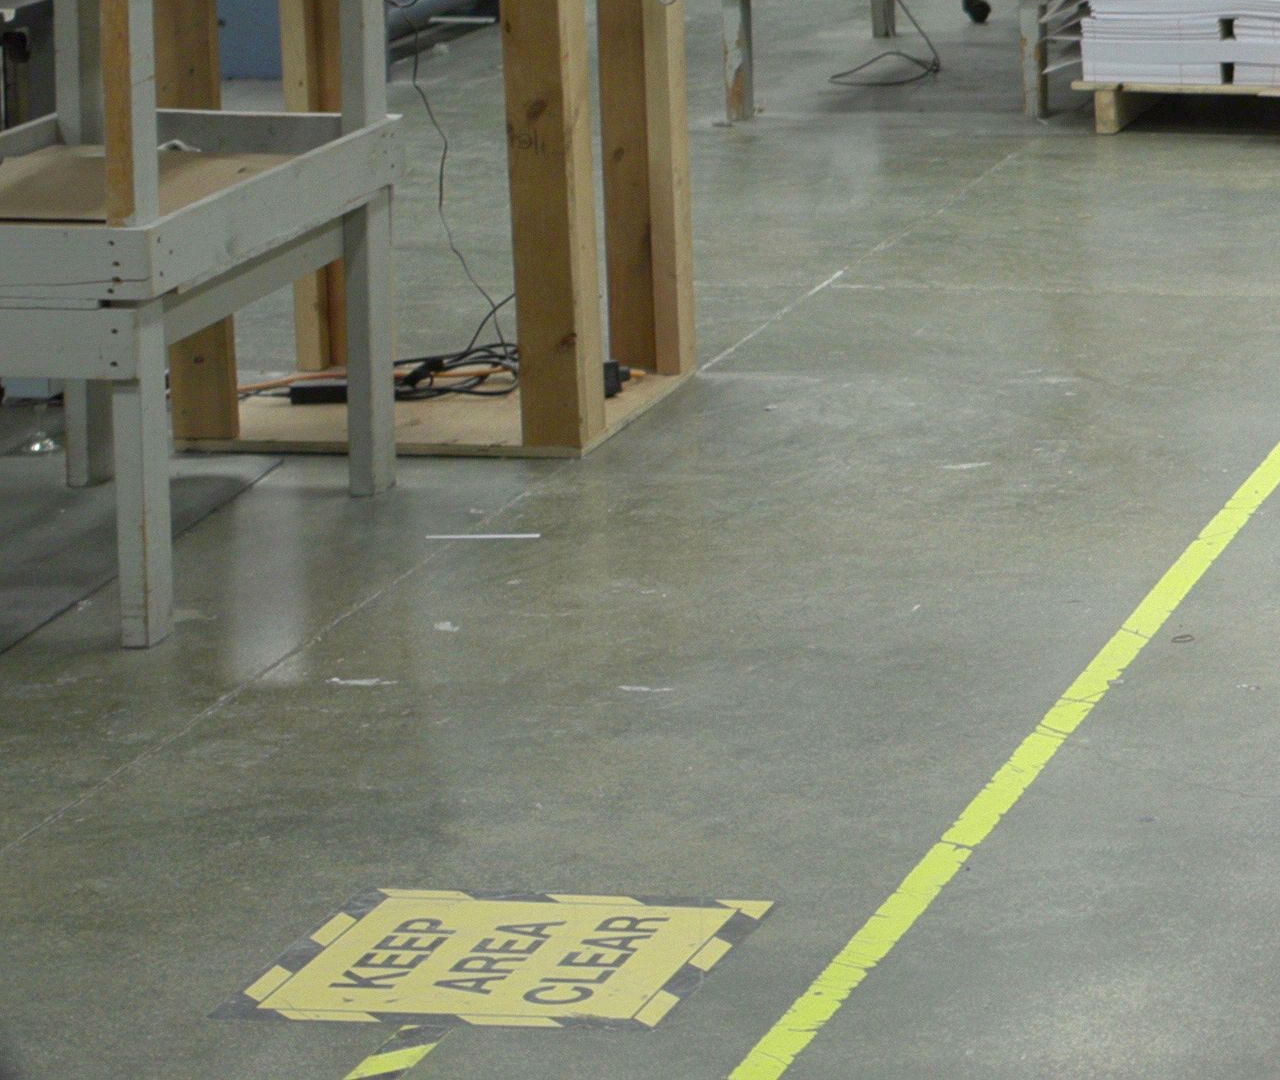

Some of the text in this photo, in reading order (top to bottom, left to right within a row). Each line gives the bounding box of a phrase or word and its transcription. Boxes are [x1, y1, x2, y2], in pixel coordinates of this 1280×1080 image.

[329, 917, 458, 989] KEEP
[432, 920, 567, 995] AREA
[522, 916, 671, 1006] CLEAR
